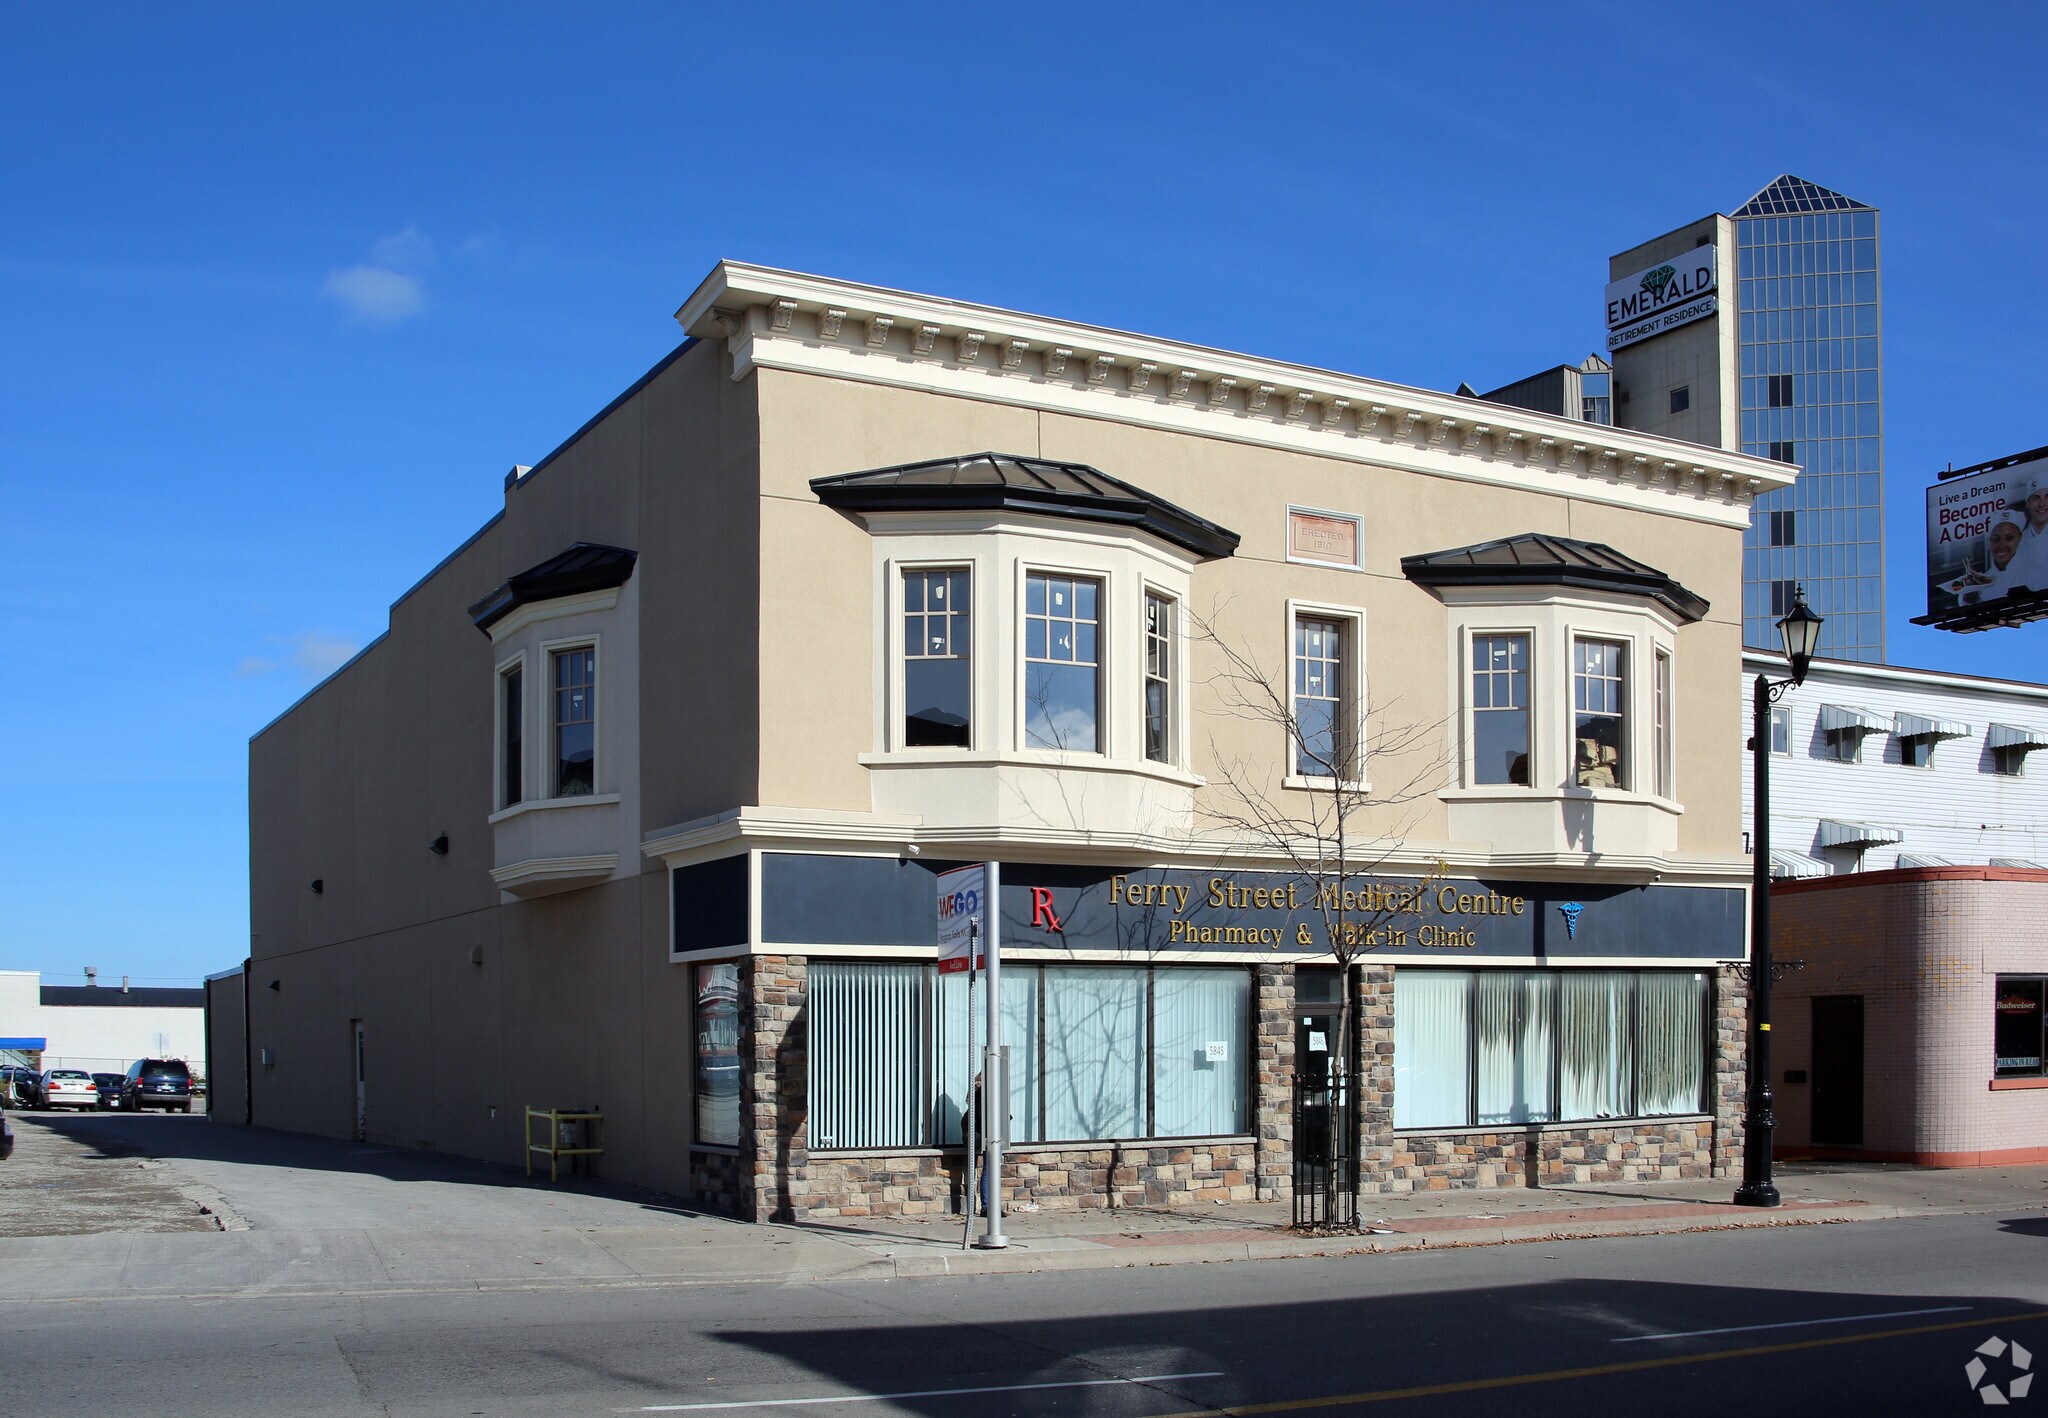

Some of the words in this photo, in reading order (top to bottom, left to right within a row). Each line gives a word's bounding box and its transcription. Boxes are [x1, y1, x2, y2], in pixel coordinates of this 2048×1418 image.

[1608, 267, 1711, 324] EMERALD
[1608, 319, 1661, 347] RETIREMENT
[1663, 300, 1712, 326] RESIDENCE
[1939, 495, 1960, 506] Live
[1962, 491, 1968, 500] a
[1970, 482, 2006, 498] Dream
[1939, 498, 2006, 525] Become
[1302, 528, 1343, 540] ERECTED
[1939, 527, 1951, 545] A
[1954, 516, 1991, 540] Chef
[939, 889, 978, 919] WEGO
[1109, 874, 1191, 914] Ferry
[1208, 877, 1299, 911] Street
[1313, 882, 1423, 913] Medical
[1438, 885, 1525, 916] Centre
[1169, 918, 1284, 950] Pharmacy
[1296, 921, 1313, 946] &
[1417, 925, 1477, 948] Clinic
[1209, 1045, 1225, 1056] 5845
[1312, 1035, 1325, 1046] 5845
